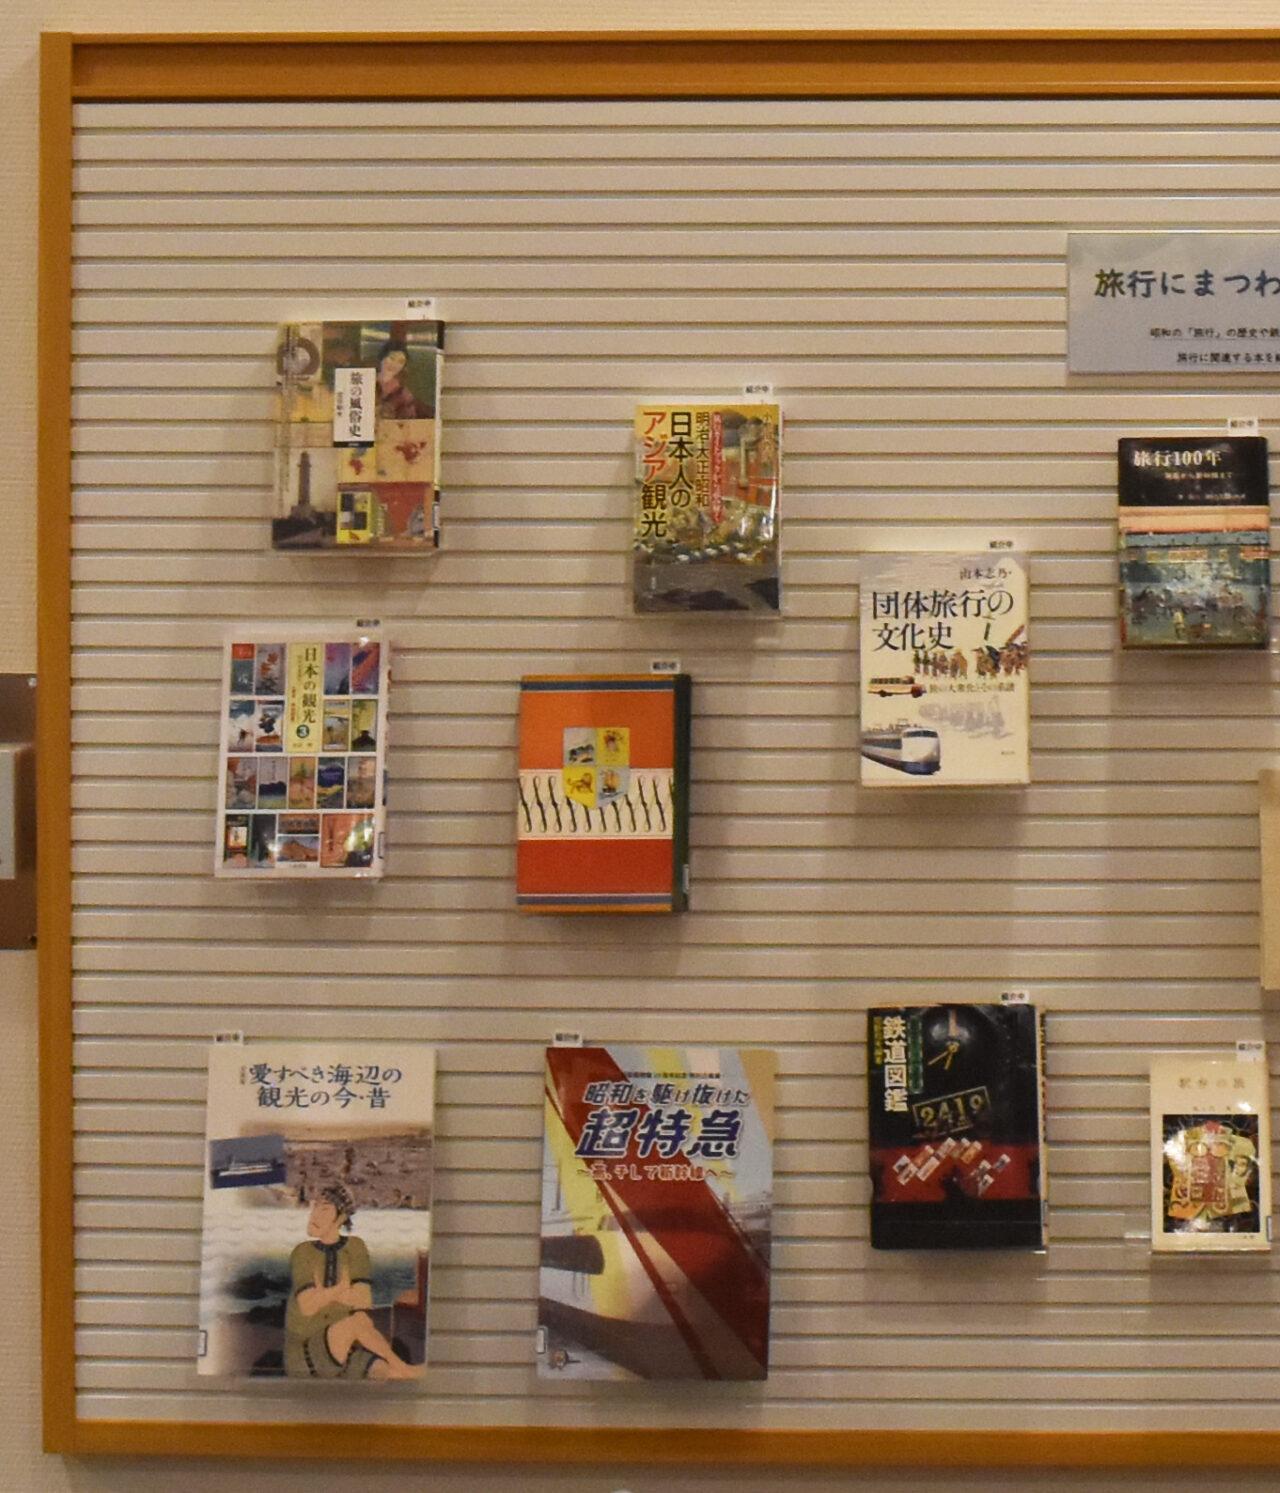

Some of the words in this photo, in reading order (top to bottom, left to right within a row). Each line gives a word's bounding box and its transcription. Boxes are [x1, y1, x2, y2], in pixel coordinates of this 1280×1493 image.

[641, 411, 667, 538] アジア観光
[668, 411, 694, 508] 日本人の
[1133, 450, 1223, 467] 旅行100年
[872, 588, 1015, 620] 団体旅行の
[872, 622, 955, 652] 文化史
[302, 647, 319, 724] 日本の観光
[250, 1063, 402, 1085] 愛すべき海辺の
[883, 1015, 909, 1112] 鉄道図鑑
[258, 1087, 391, 1109] 観光の今・昔
[584, 1083, 750, 1106] 昭和を駆け抜けた
[574, 1109, 746, 1158] 超特急
